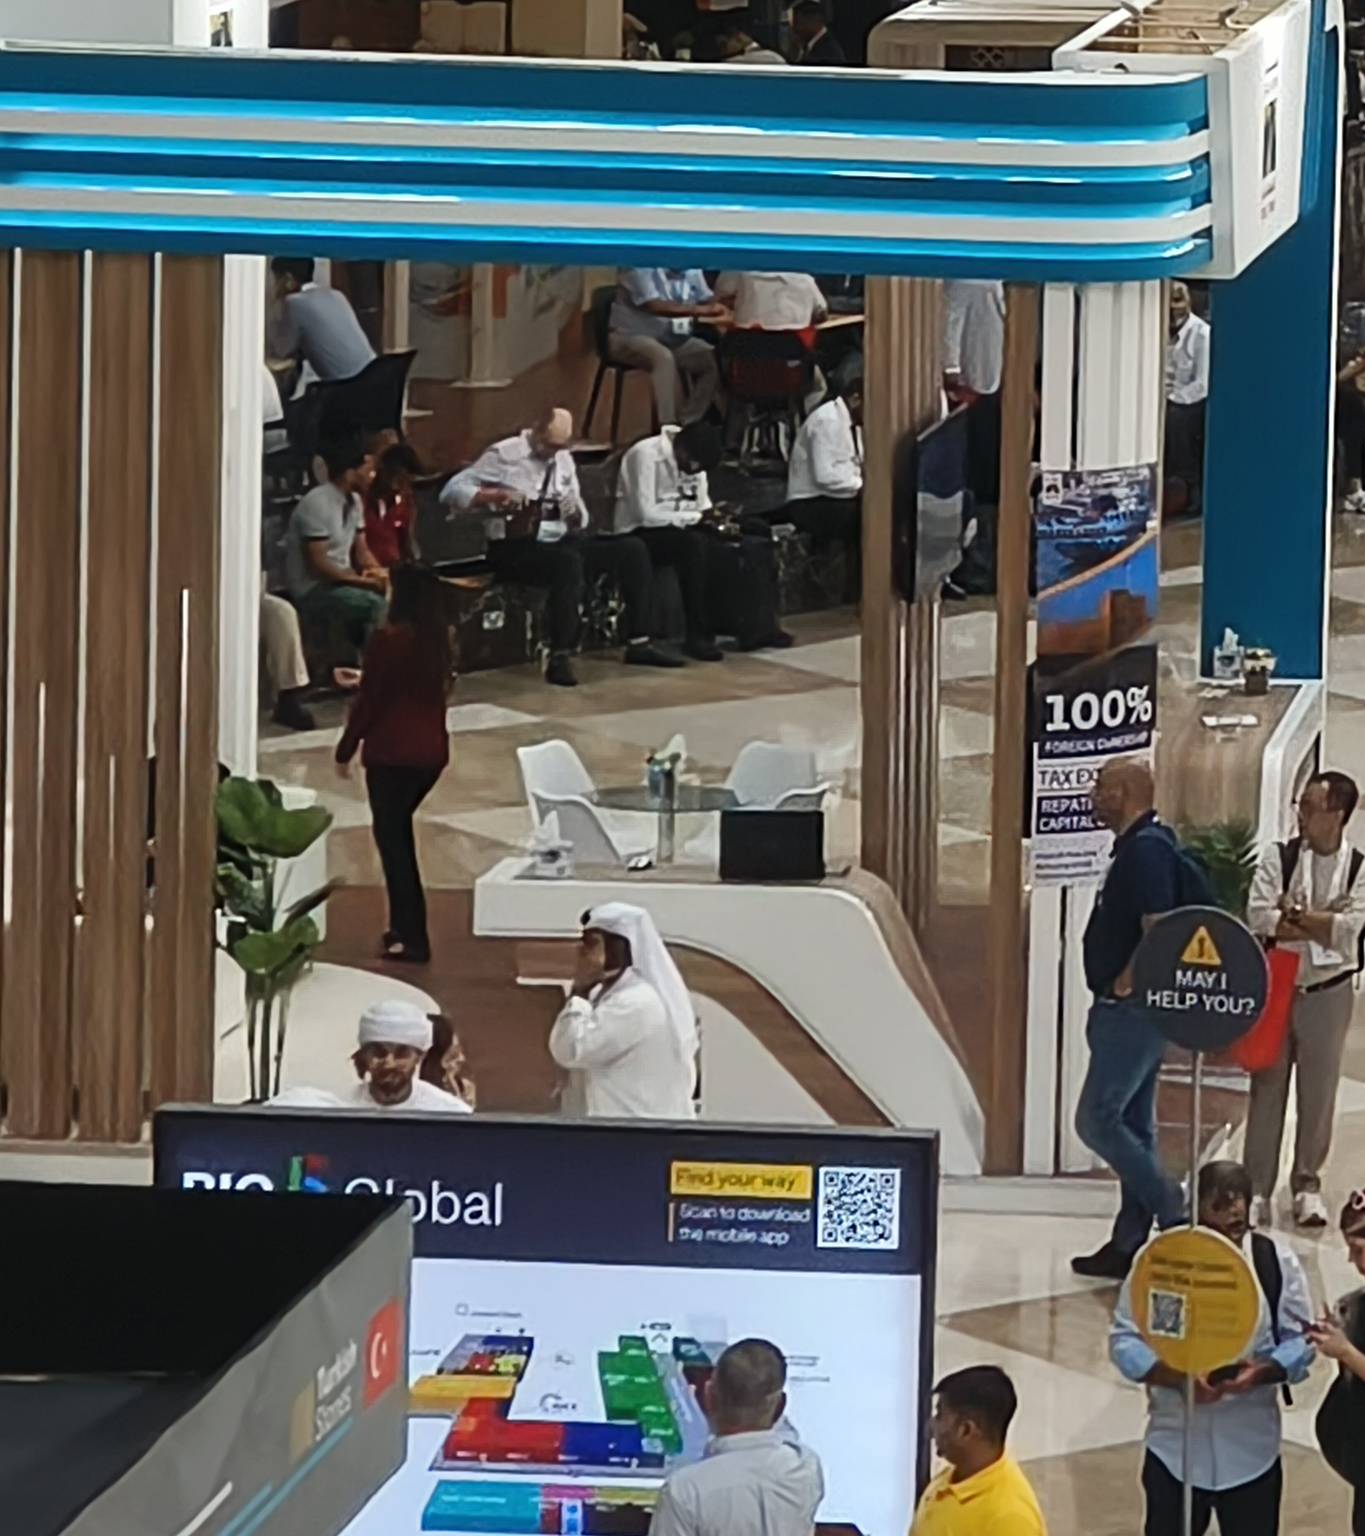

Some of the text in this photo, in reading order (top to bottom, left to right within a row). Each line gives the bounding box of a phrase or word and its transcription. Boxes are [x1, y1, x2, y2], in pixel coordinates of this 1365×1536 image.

[1045, 685, 1152, 732] 100%
[1044, 739, 1095, 754] FOREIGN
[1038, 769, 1073, 787] TAX
[1039, 816, 1094, 832] CAPITAL
[1176, 969, 1227, 990] MAY I
[1146, 989, 1255, 1015] HELP YOU?
[674, 1168, 796, 1191] Find your way
[680, 1203, 811, 1223] Scan to download
[758, 1230, 790, 1246] app
